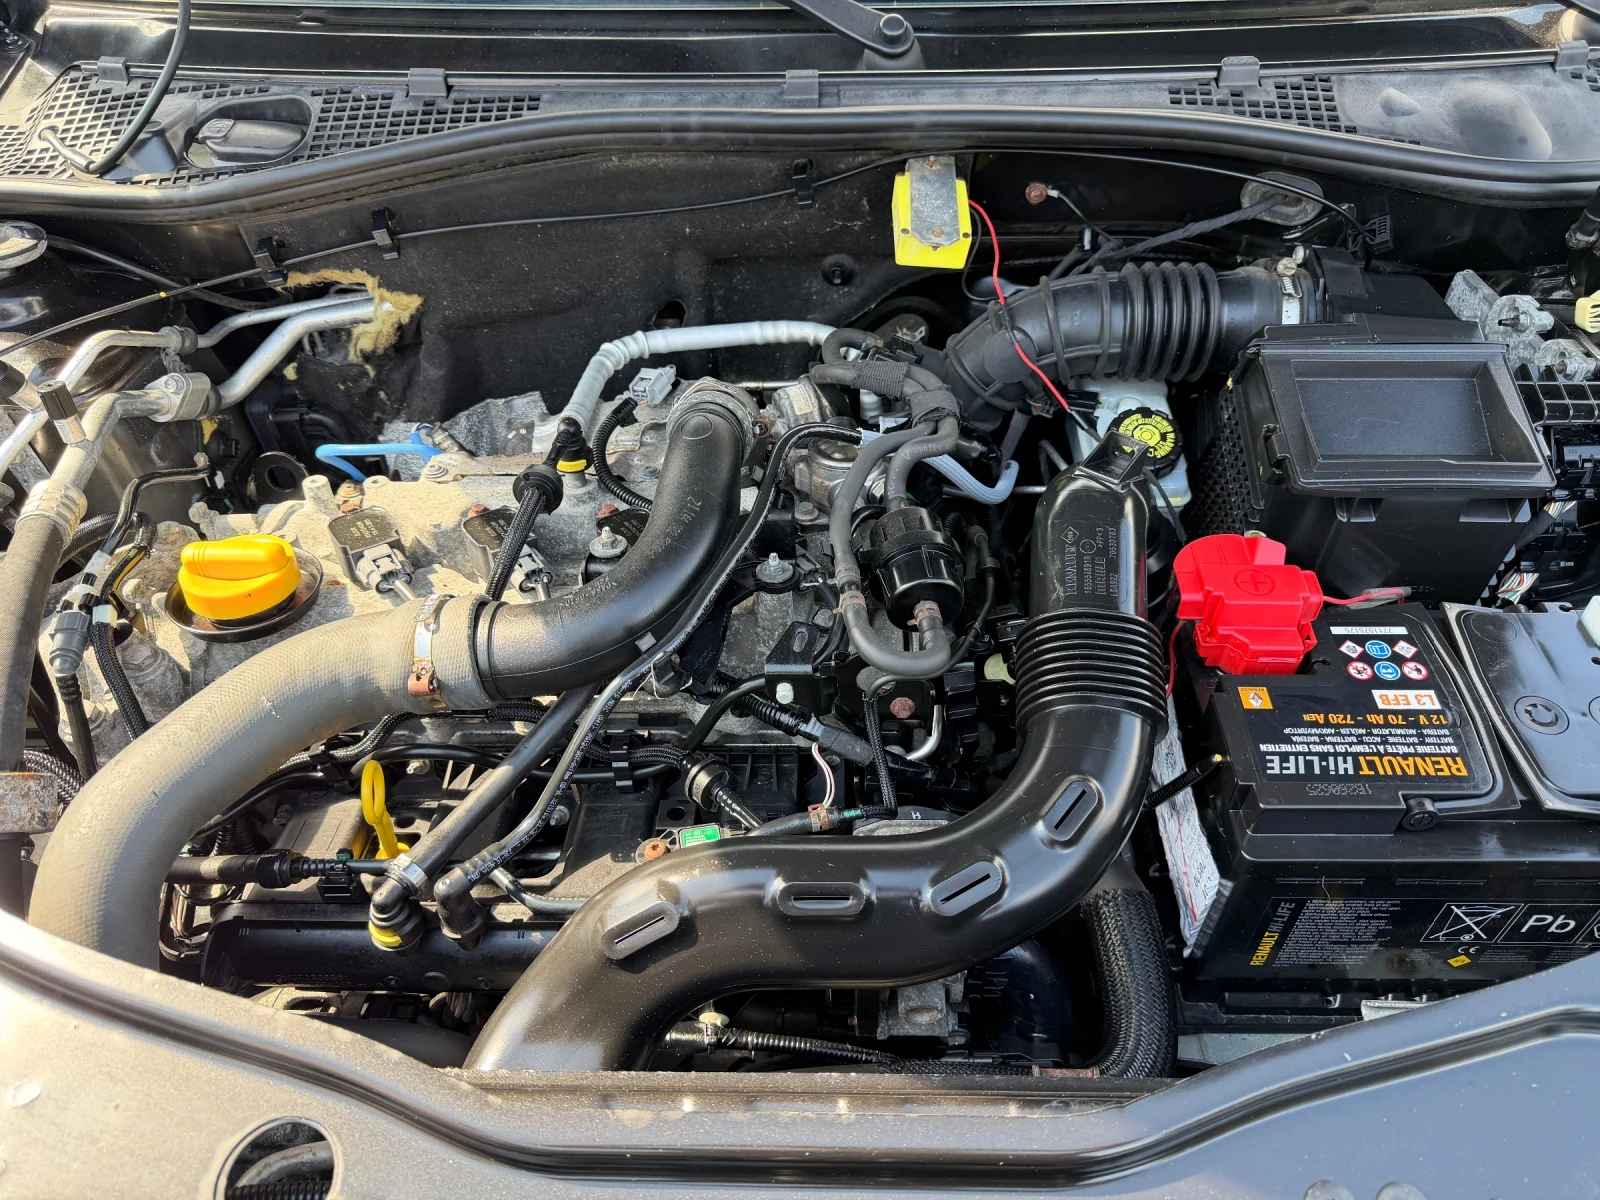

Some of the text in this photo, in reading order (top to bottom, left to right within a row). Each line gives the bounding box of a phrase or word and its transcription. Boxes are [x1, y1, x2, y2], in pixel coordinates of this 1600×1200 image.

[1064, 544, 1077, 596] RENAULT
[1378, 694, 1436, 706] L3 EFB
[1328, 714, 1354, 724] 720
[1366, 714, 1384, 724] Ah
[1388, 714, 1406, 724] 70
[1418, 714, 1430, 724] V
[1430, 714, 1448, 724] 12
[1424, 736, 1453, 744] BATTERY
[1259, 743, 1308, 752] ENTRETIEN
[1310, 744, 1334, 752] SANS
[1336, 744, 1376, 753] L'EMPLOI
[1386, 744, 1414, 755] PRÊTE
[1415, 745, 1458, 754] BATTERIE
[1266, 755, 1468, 776] RENAULT Hi-LIFE
[1520, 914, 1577, 933] Pb
[1250, 901, 1296, 967] RENAULT Hi-LIFE
